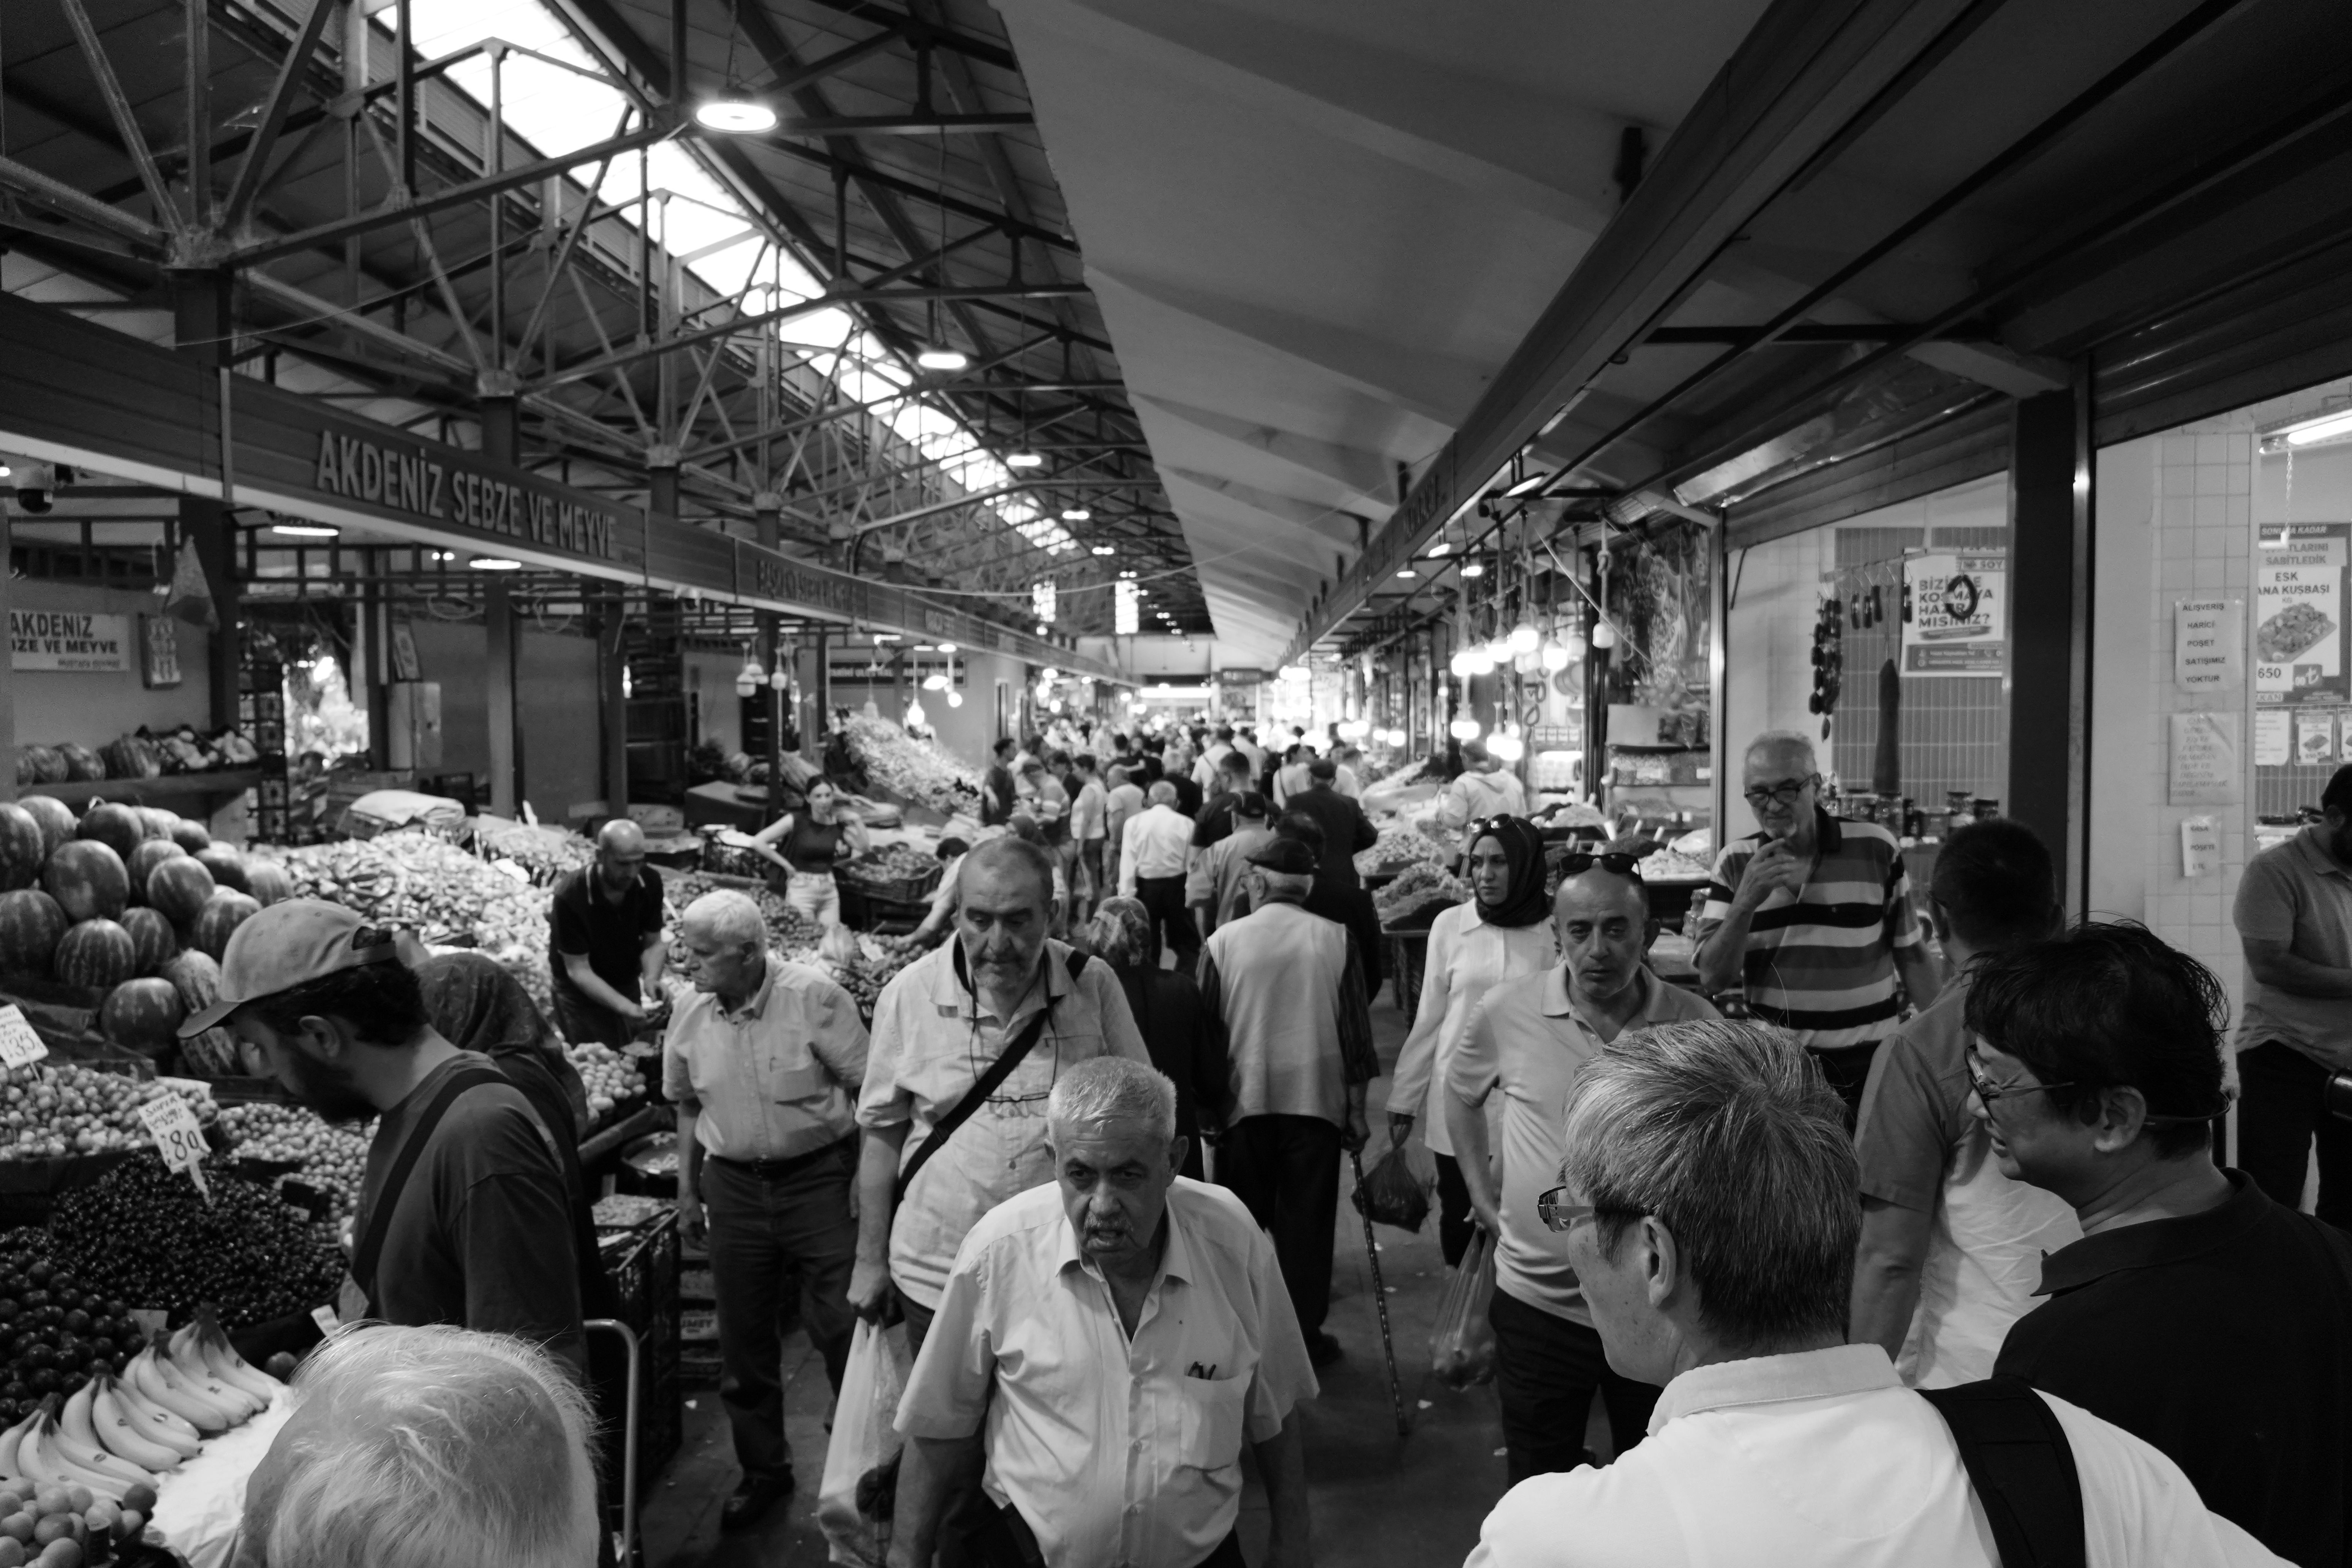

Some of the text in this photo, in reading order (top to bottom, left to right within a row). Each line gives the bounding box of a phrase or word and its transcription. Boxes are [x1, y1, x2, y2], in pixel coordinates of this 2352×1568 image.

[317, 429, 617, 558] AKDENİZ SEBZE VE MEYVE
[2275, 571, 2298, 582] ESK
[2281, 584, 2330, 596] KUŞBAŞI
[44, 639, 61, 654] VE
[66, 640, 118, 654] MEYVE
[2258, 667, 2281, 679] 650
[170, 1130, 200, 1161] 80
